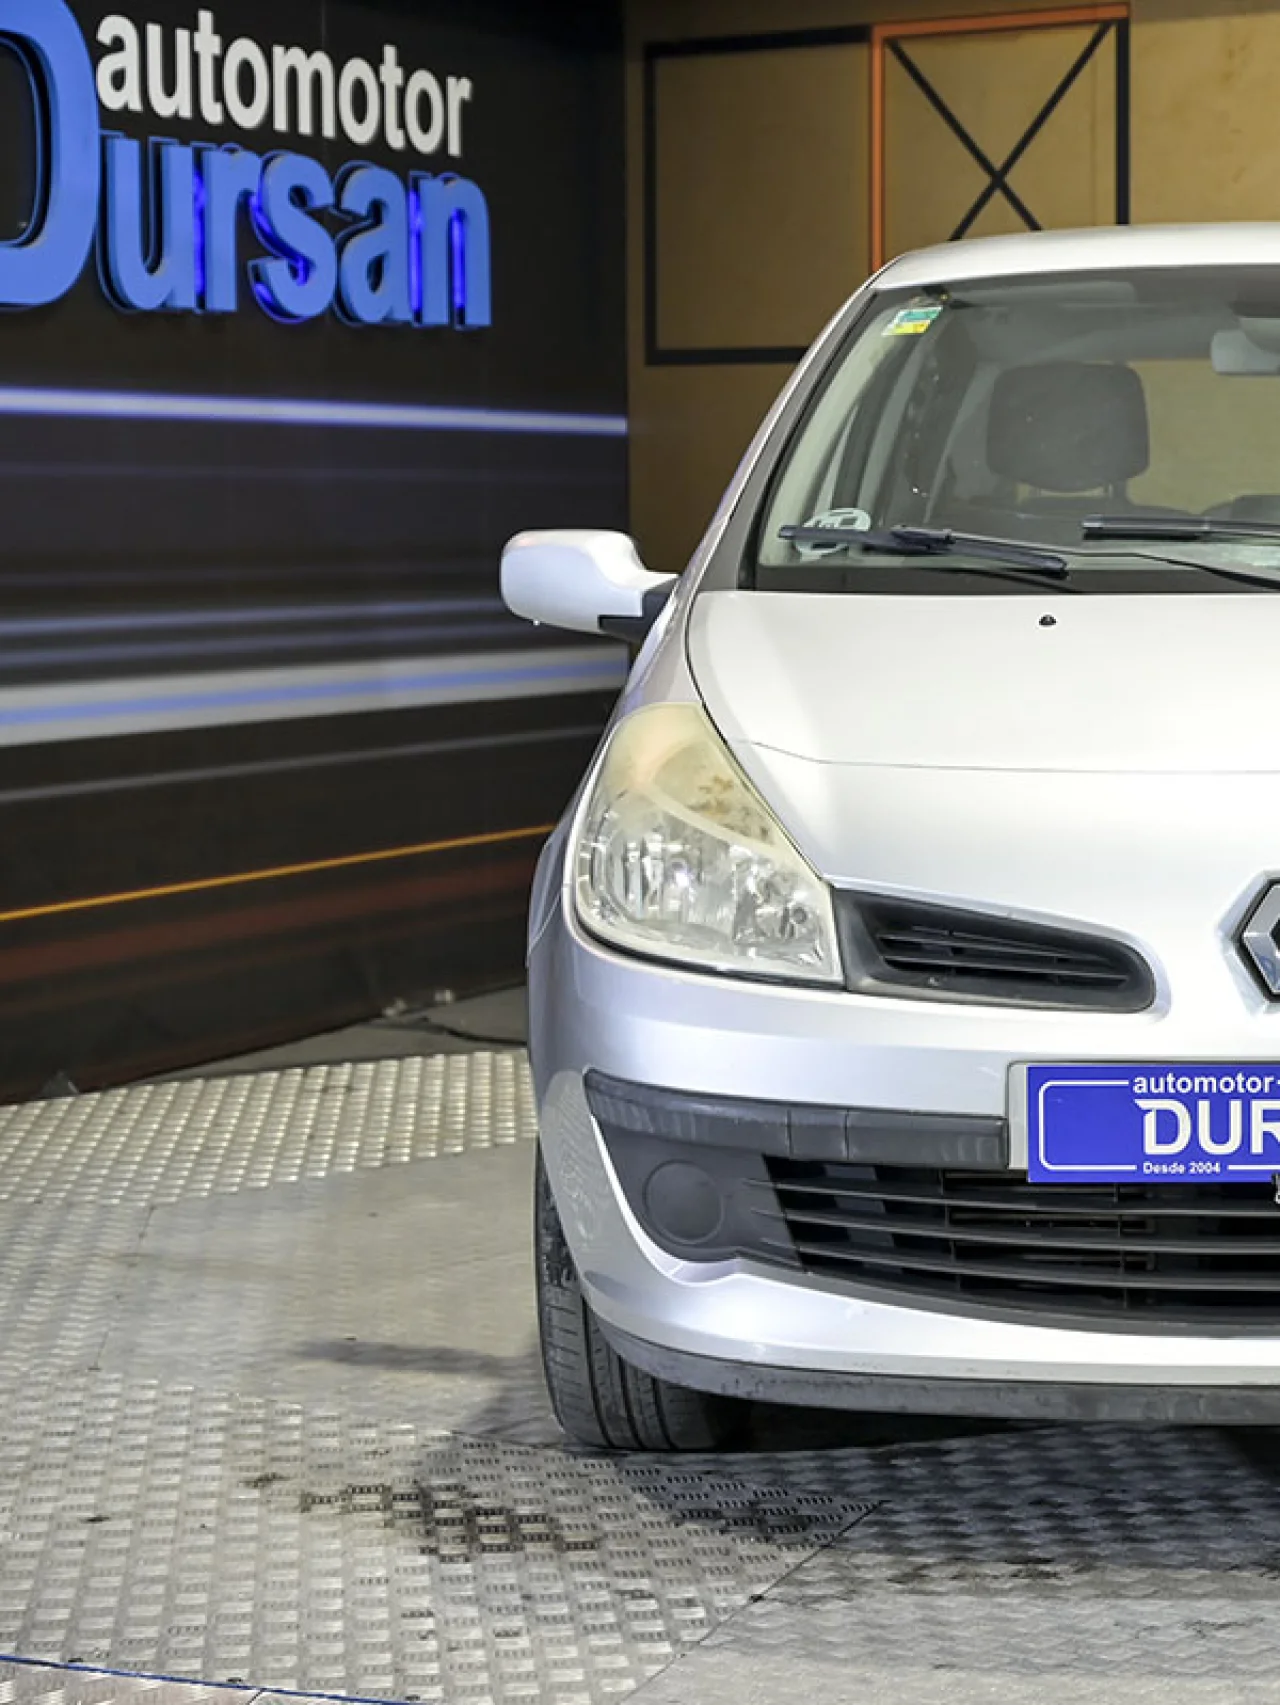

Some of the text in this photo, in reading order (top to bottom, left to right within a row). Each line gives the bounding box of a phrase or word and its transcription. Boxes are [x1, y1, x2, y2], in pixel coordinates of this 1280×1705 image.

[97, 9, 472, 157] automotor
[1132, 1072, 1275, 1094] automotor
[1142, 1160, 1221, 1174] Desde 2004
